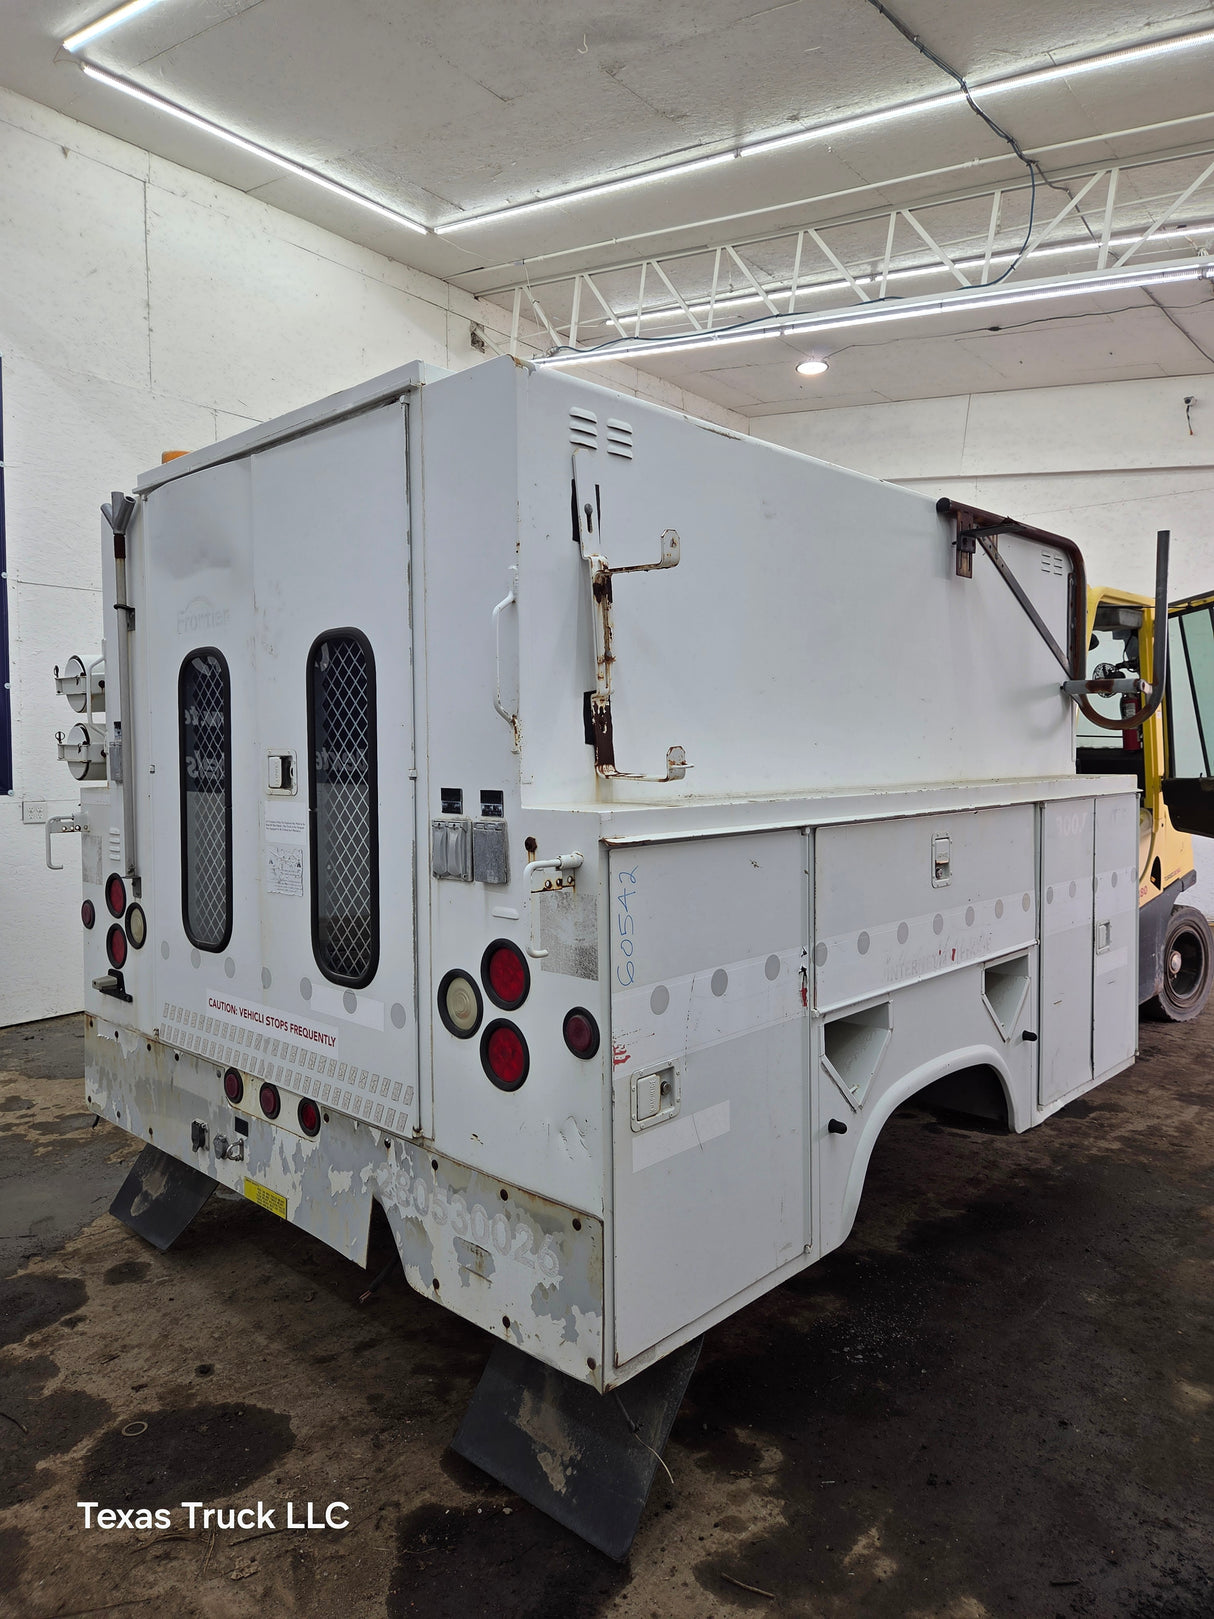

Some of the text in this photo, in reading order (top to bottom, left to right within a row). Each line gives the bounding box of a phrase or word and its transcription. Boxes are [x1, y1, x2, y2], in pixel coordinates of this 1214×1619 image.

[616, 865, 639, 986] 60542
[208, 997, 238, 1016] CAUTION:
[265, 1016, 288, 1032] STOPS
[290, 1023, 337, 1048] FREQUENTLY
